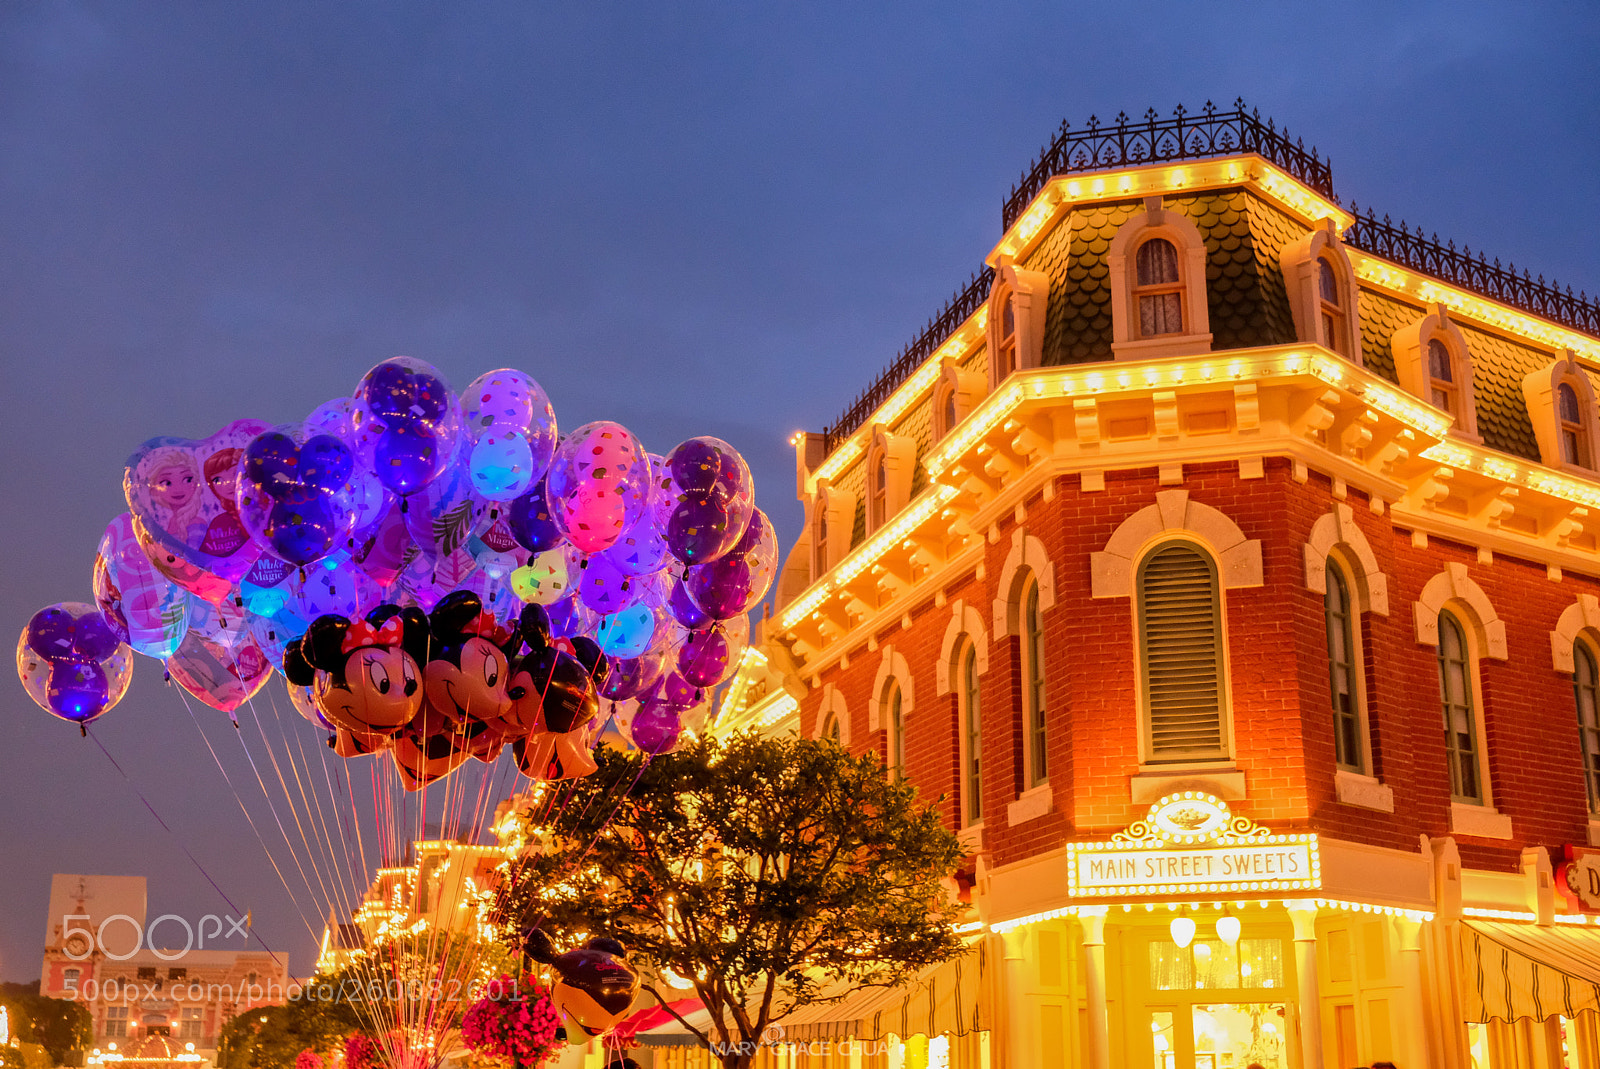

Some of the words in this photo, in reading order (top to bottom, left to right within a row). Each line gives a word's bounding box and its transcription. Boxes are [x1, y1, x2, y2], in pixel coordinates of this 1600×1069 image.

[257, 558, 284, 570] Make
[252, 571, 284, 583] Magic
[1090, 858, 1136, 880] MAIN
[1145, 855, 1213, 878] STREET
[1222, 852, 1299, 876] SWEETS
